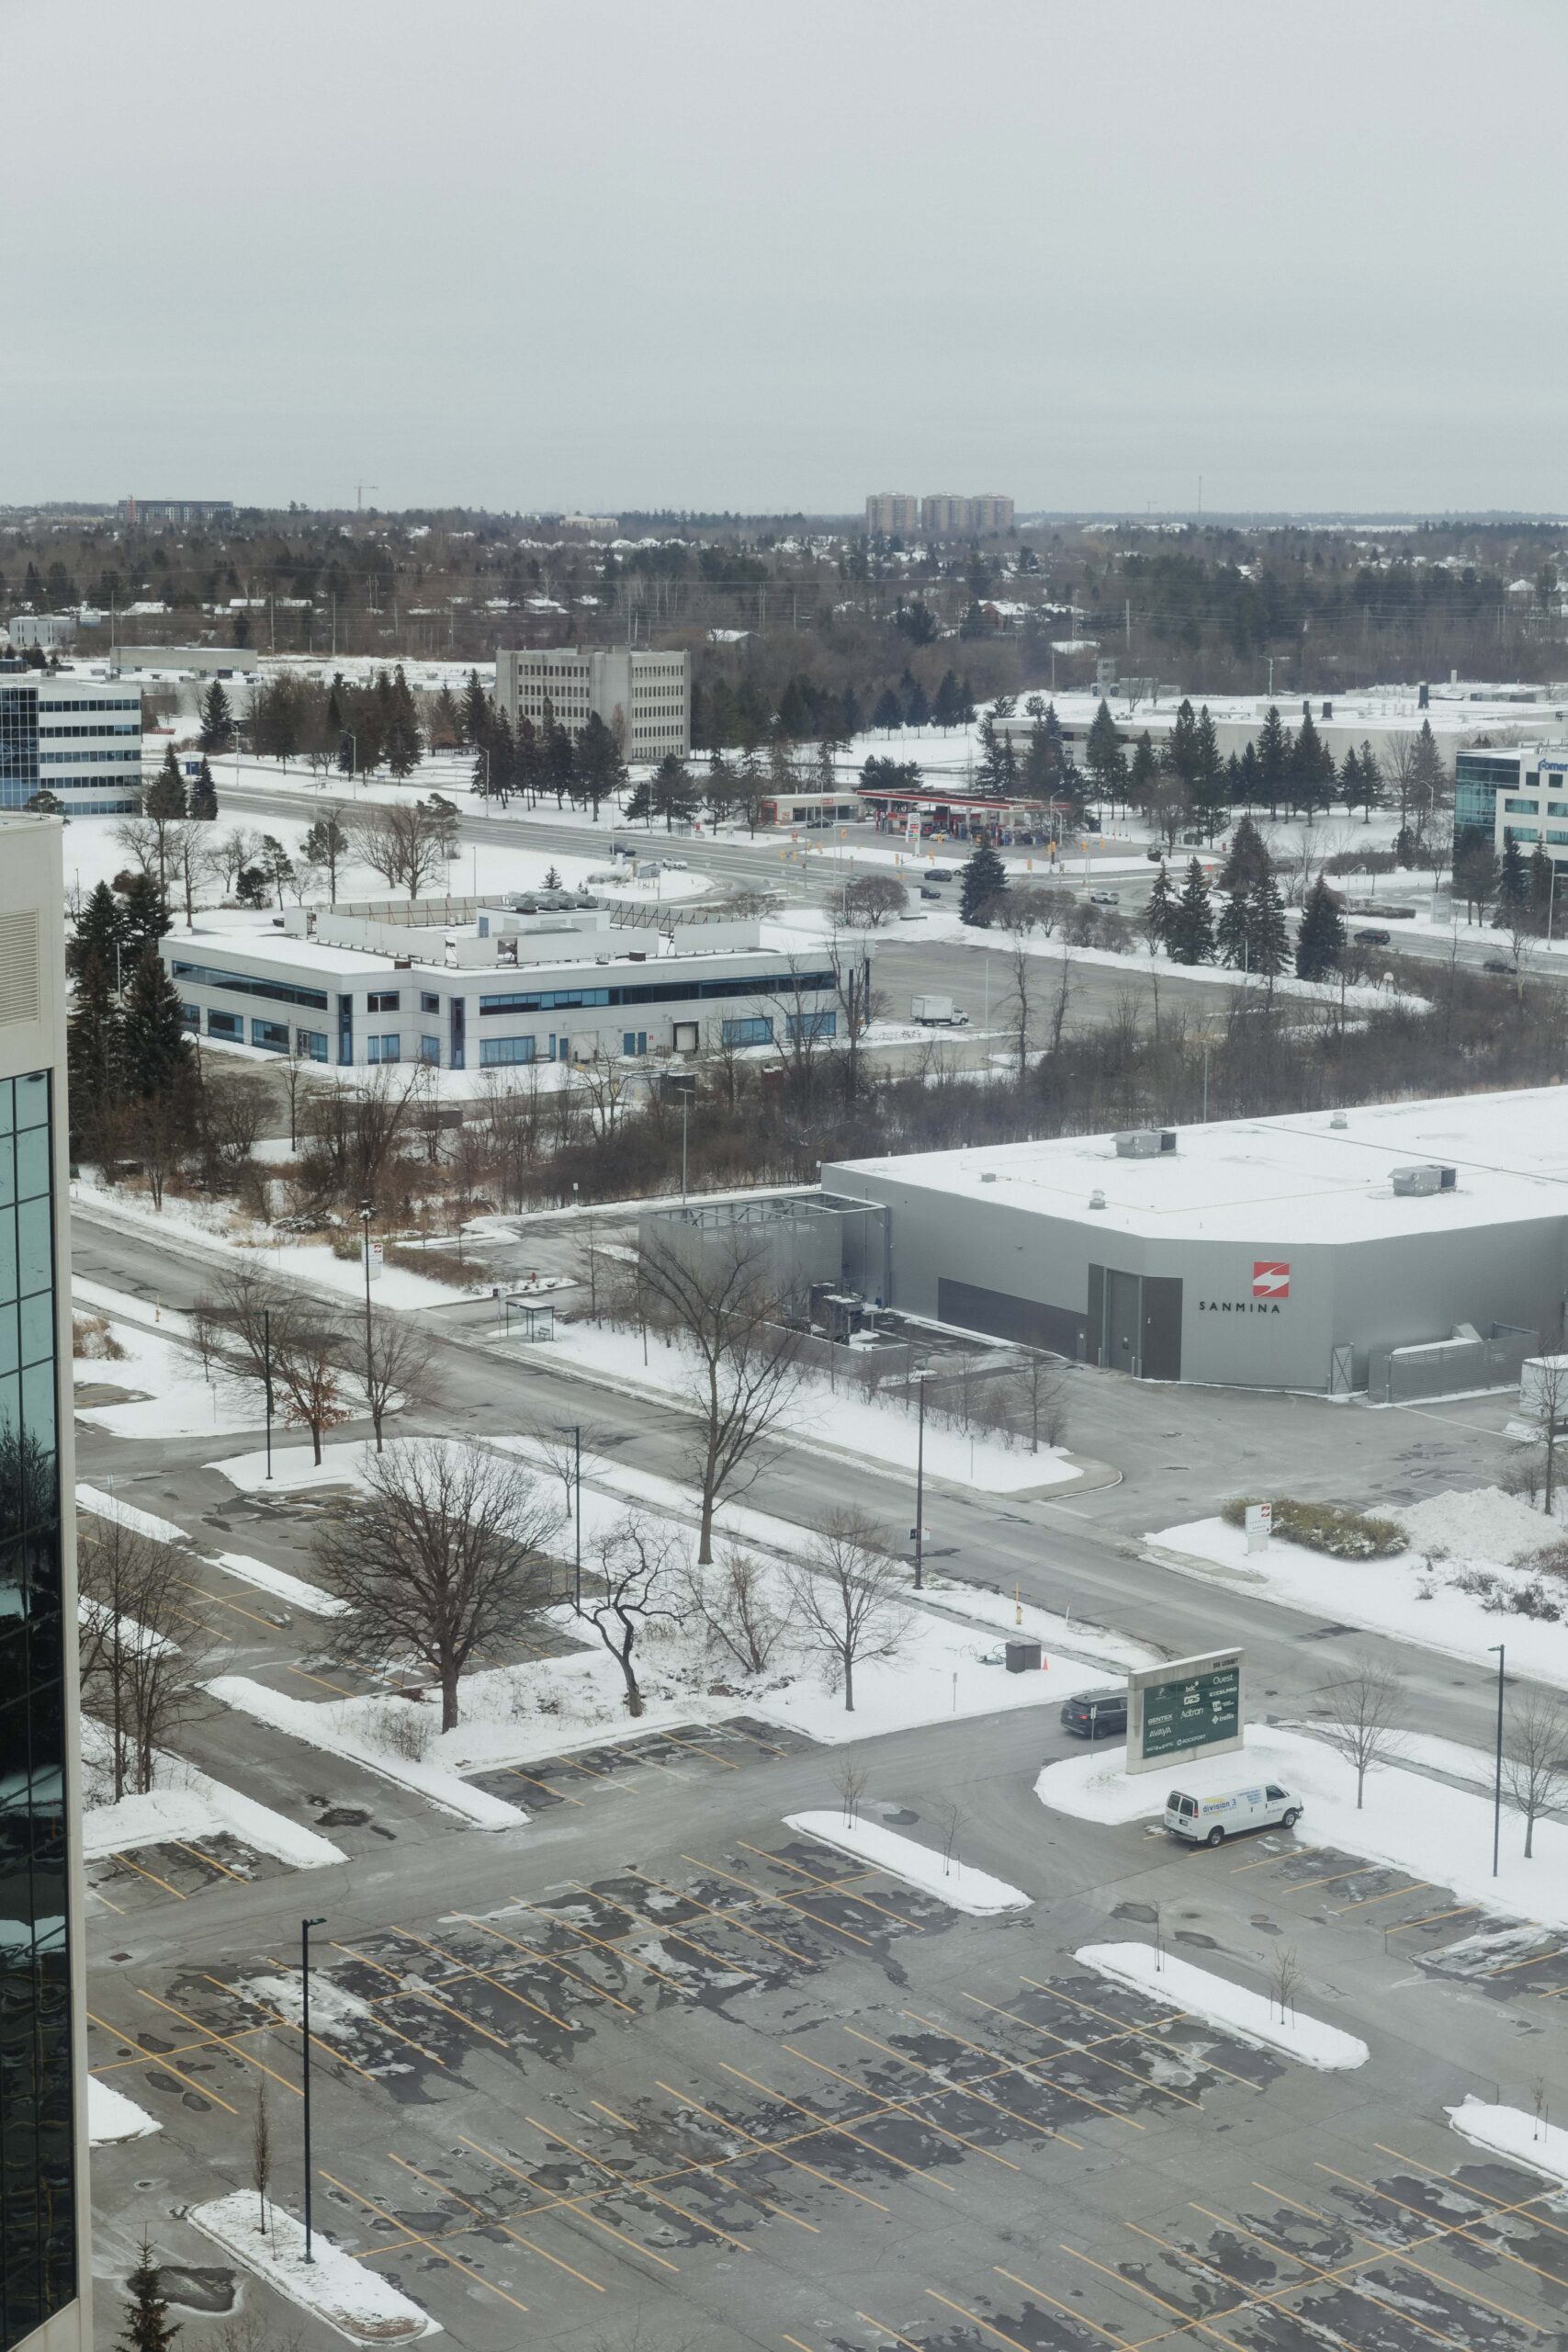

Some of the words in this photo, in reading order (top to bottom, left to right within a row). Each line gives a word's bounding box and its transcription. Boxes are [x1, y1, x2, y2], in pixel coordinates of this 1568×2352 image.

[1199, 1301, 1280, 1314] SANMINA
[1147, 1713, 1173, 1724] GENTEX
[1219, 1713, 1235, 1722] trellis
[1149, 1726, 1172, 1737] AVAYA
[1182, 1734, 1206, 1743] ROCKPORT
[1202, 1801, 1231, 1813] division
[1231, 1798, 1236, 1806] 3
